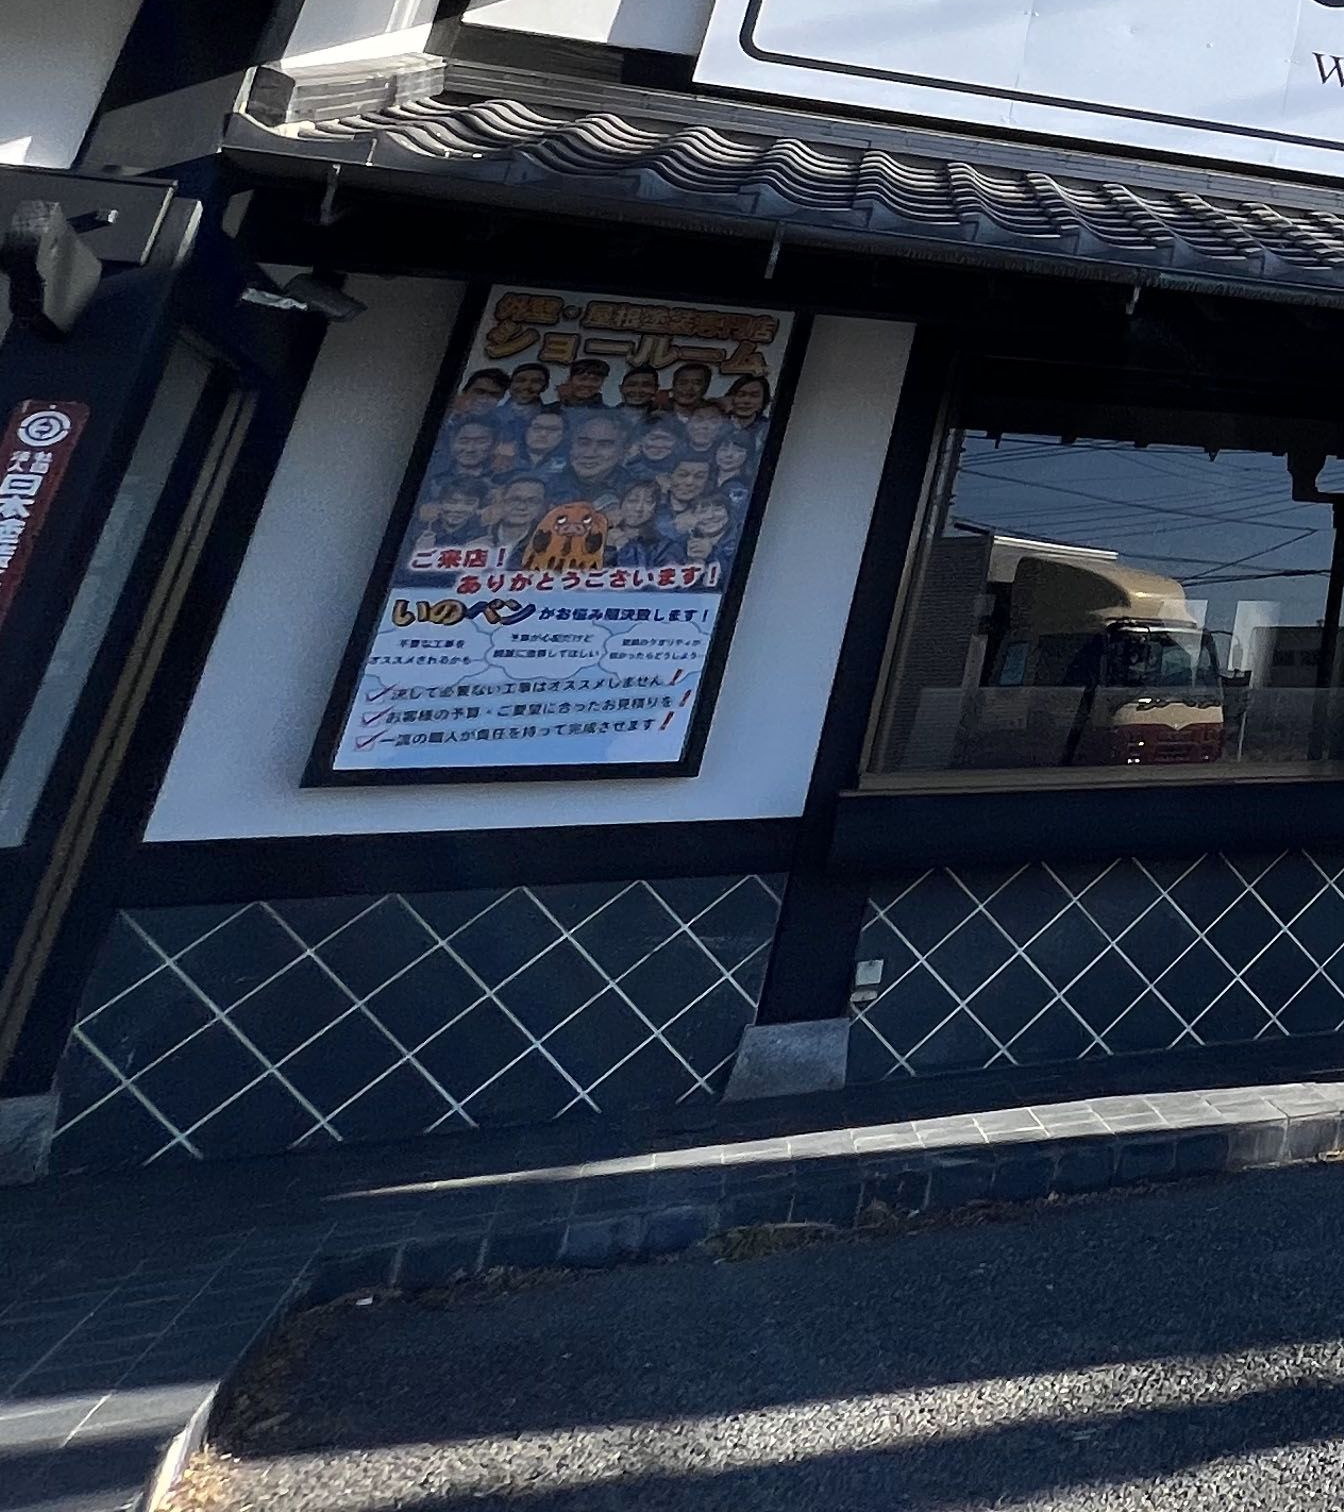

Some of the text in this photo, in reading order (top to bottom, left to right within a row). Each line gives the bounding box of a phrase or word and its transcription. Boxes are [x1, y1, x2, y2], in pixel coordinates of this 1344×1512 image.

[485, 319, 770, 377] ショールーム
[392, 598, 536, 626] いのペン
